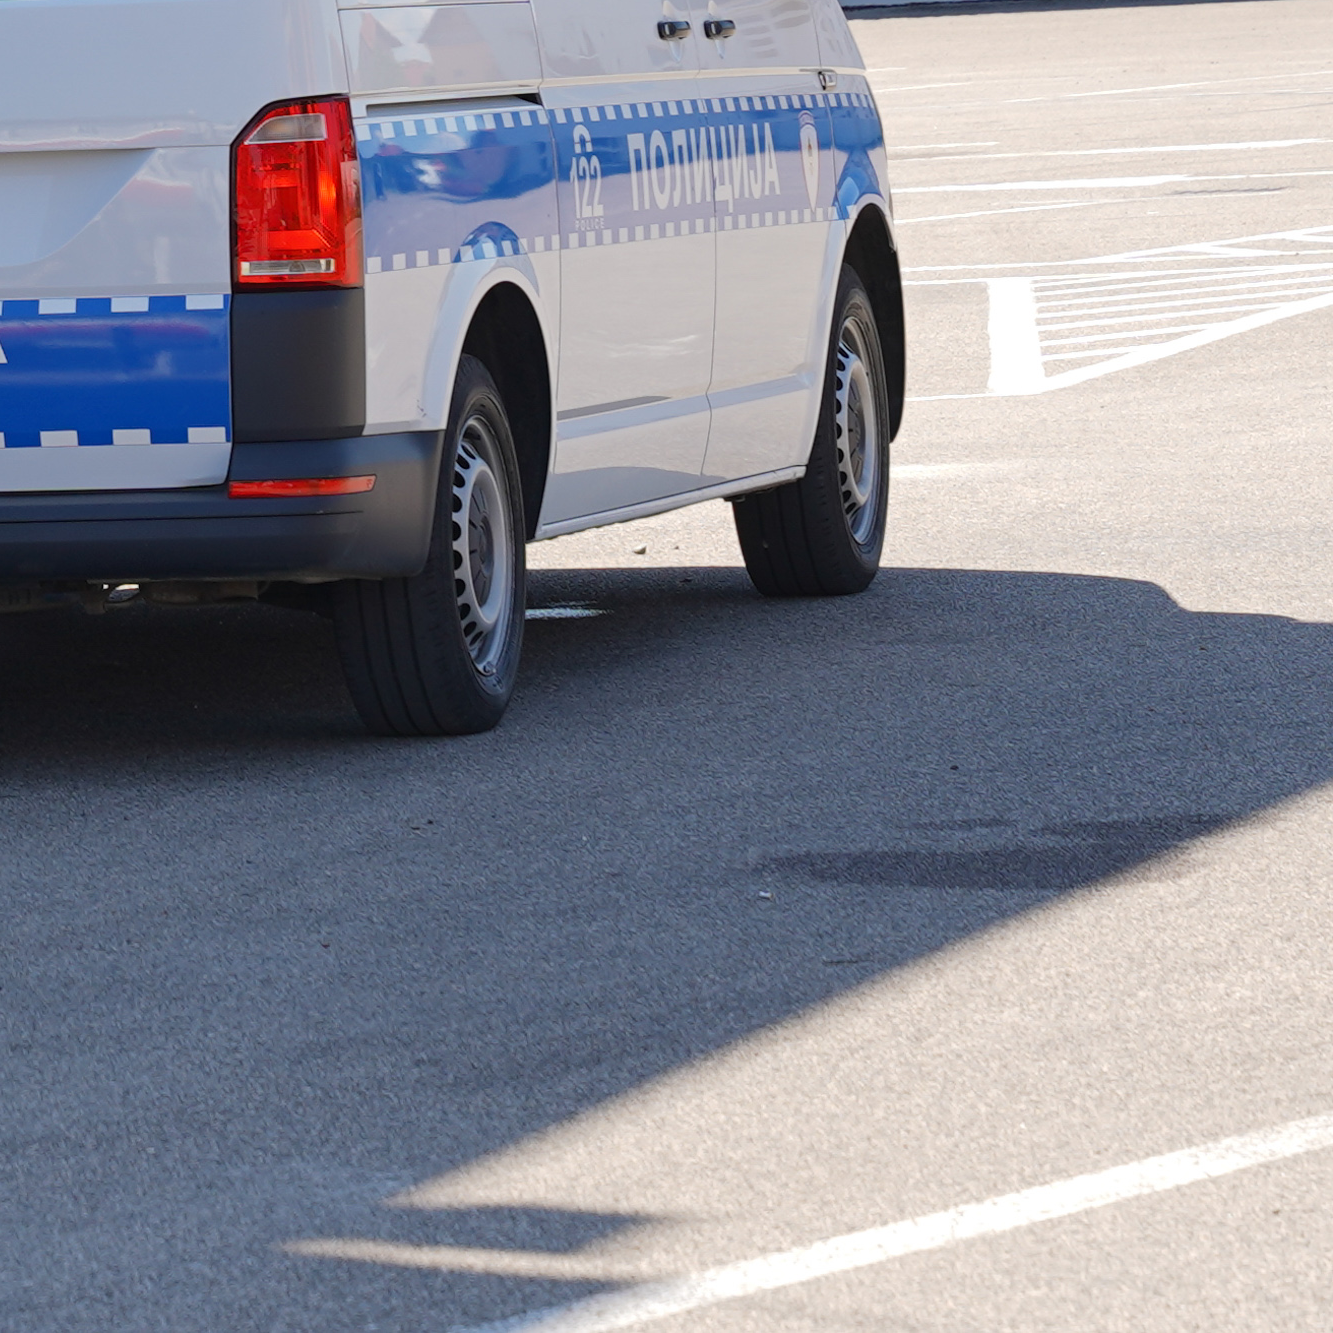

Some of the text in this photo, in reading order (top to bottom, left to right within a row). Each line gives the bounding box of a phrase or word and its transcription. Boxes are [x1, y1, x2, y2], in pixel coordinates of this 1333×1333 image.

[570, 155, 604, 219] 122
[626, 122, 781, 213] ПОЛИЦИЈА
[575, 217, 605, 231] POLICE
